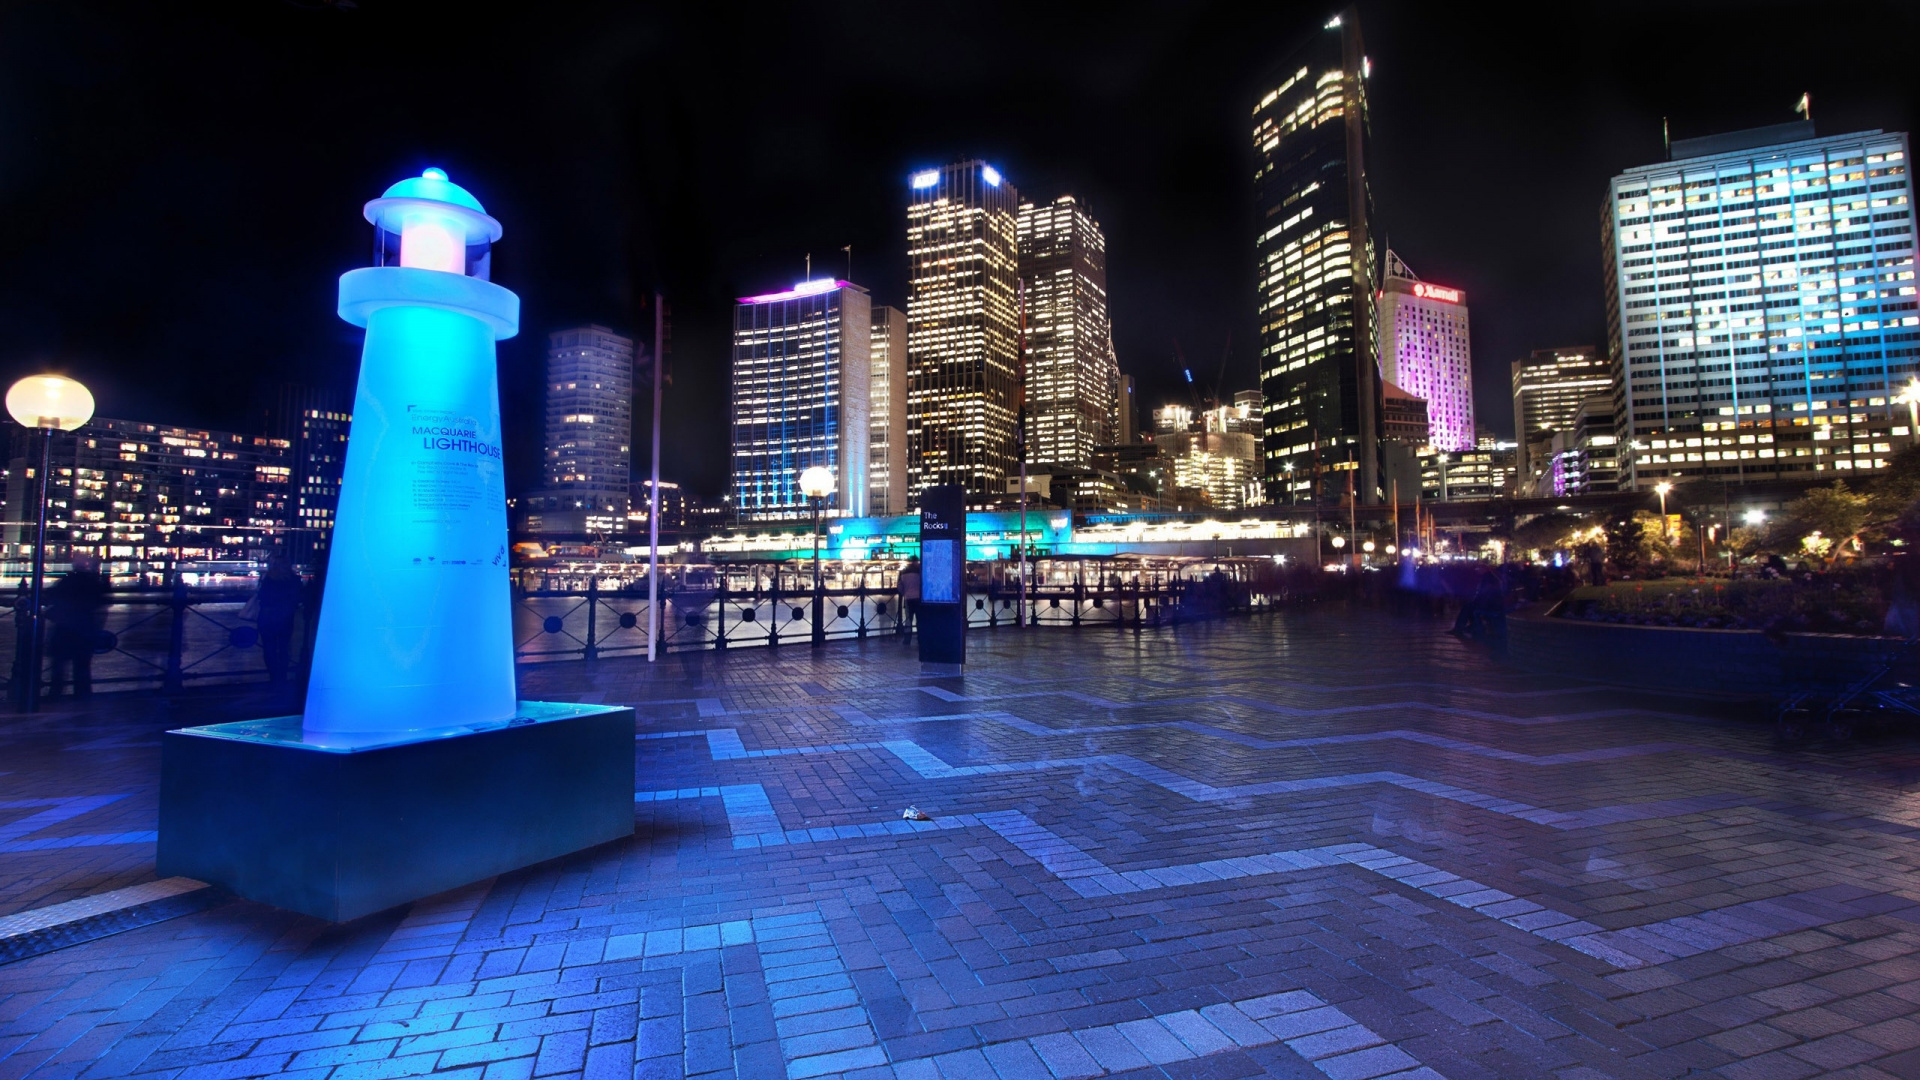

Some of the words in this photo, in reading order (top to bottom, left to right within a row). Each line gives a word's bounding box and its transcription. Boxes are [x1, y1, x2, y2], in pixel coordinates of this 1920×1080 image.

[412, 426, 476, 439] MACQUARIE
[423, 437, 500, 459] LIGHTHOUSE
[923, 511, 937, 519] The
[923, 521, 944, 530] Rocks
